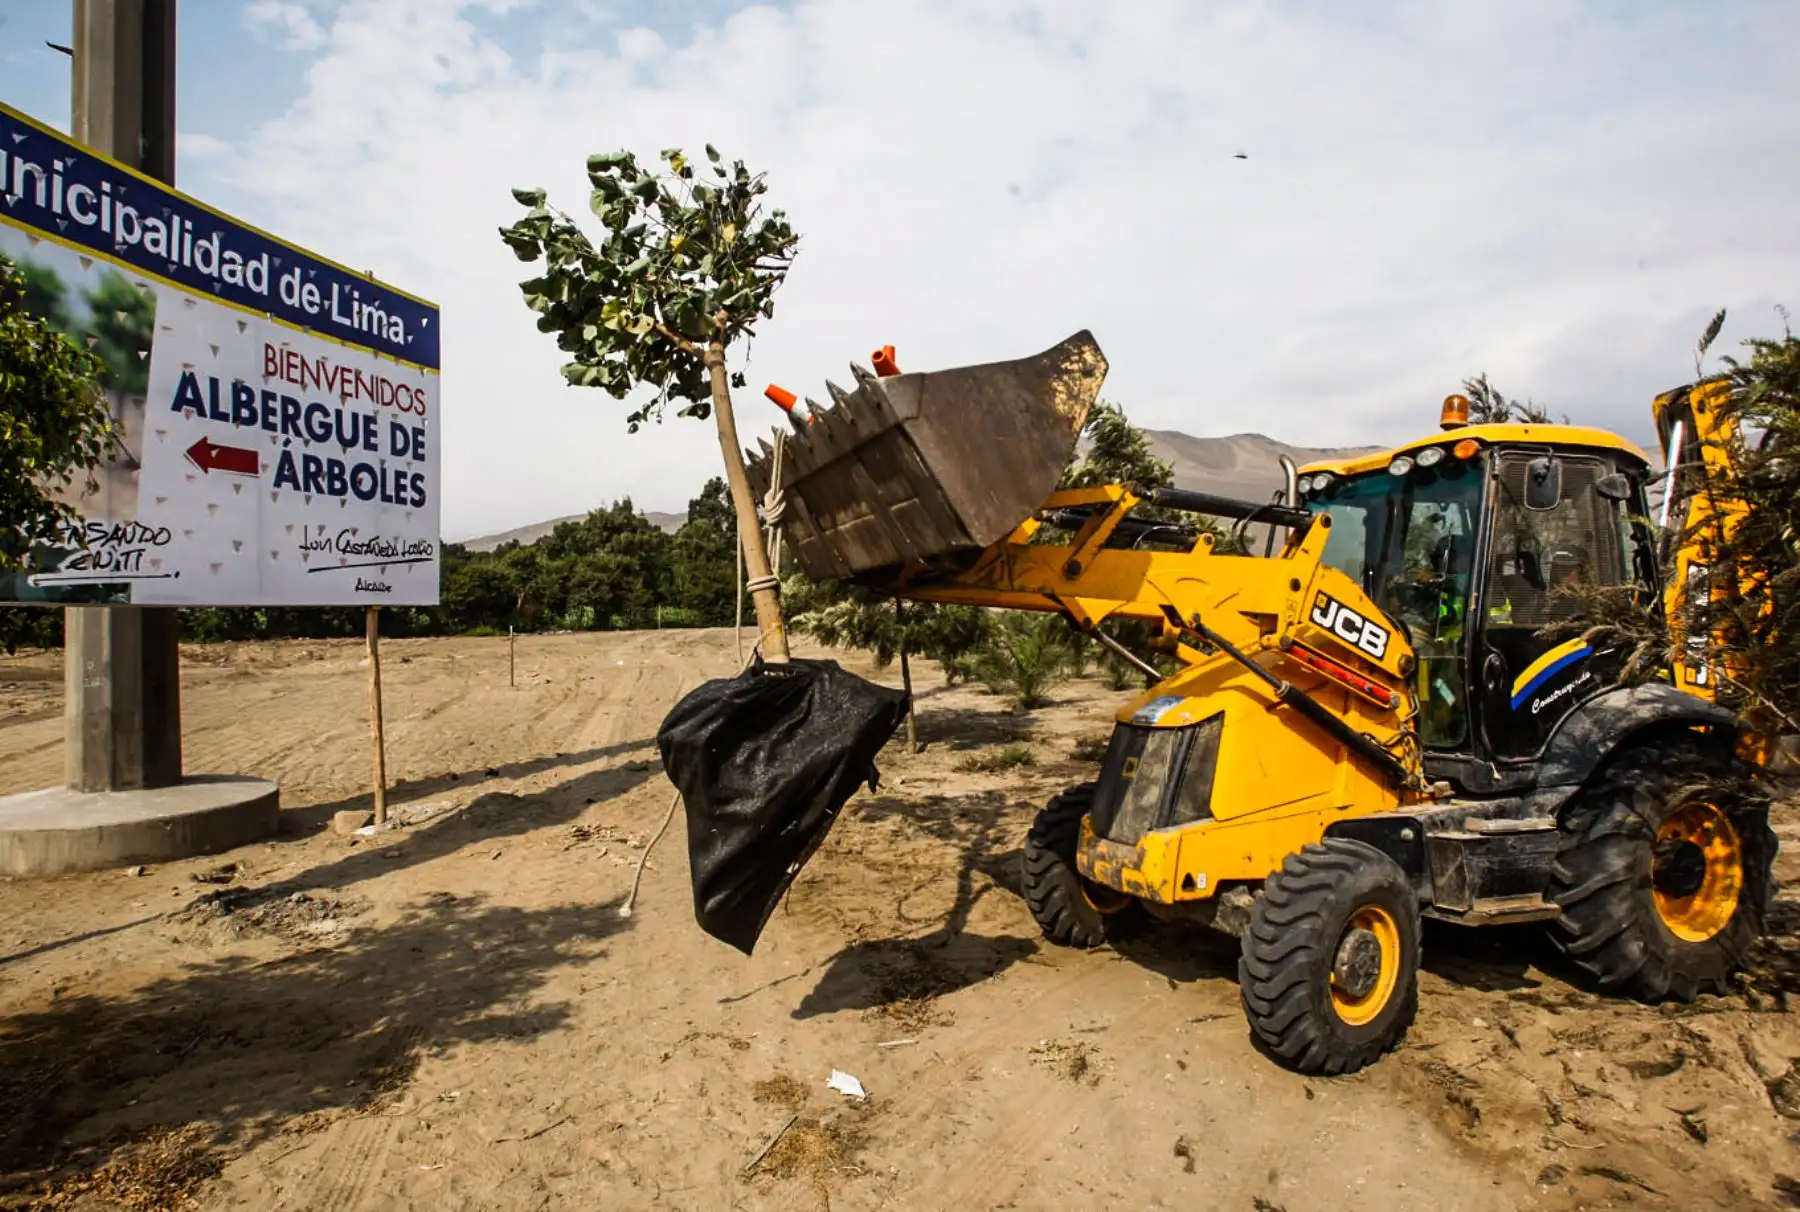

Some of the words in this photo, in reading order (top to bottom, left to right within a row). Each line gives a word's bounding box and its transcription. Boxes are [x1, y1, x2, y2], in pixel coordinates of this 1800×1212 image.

[0, 148, 269, 296] nicipalidad
[279, 268, 320, 315] de
[331, 282, 406, 345] Lima
[171, 370, 379, 452] ALBERGUE
[390, 418, 427, 463] DE
[264, 342, 427, 417] BIENVENIDOS
[273, 438, 427, 509] ÁRBOLES
[1312, 600, 1387, 657] JCB
